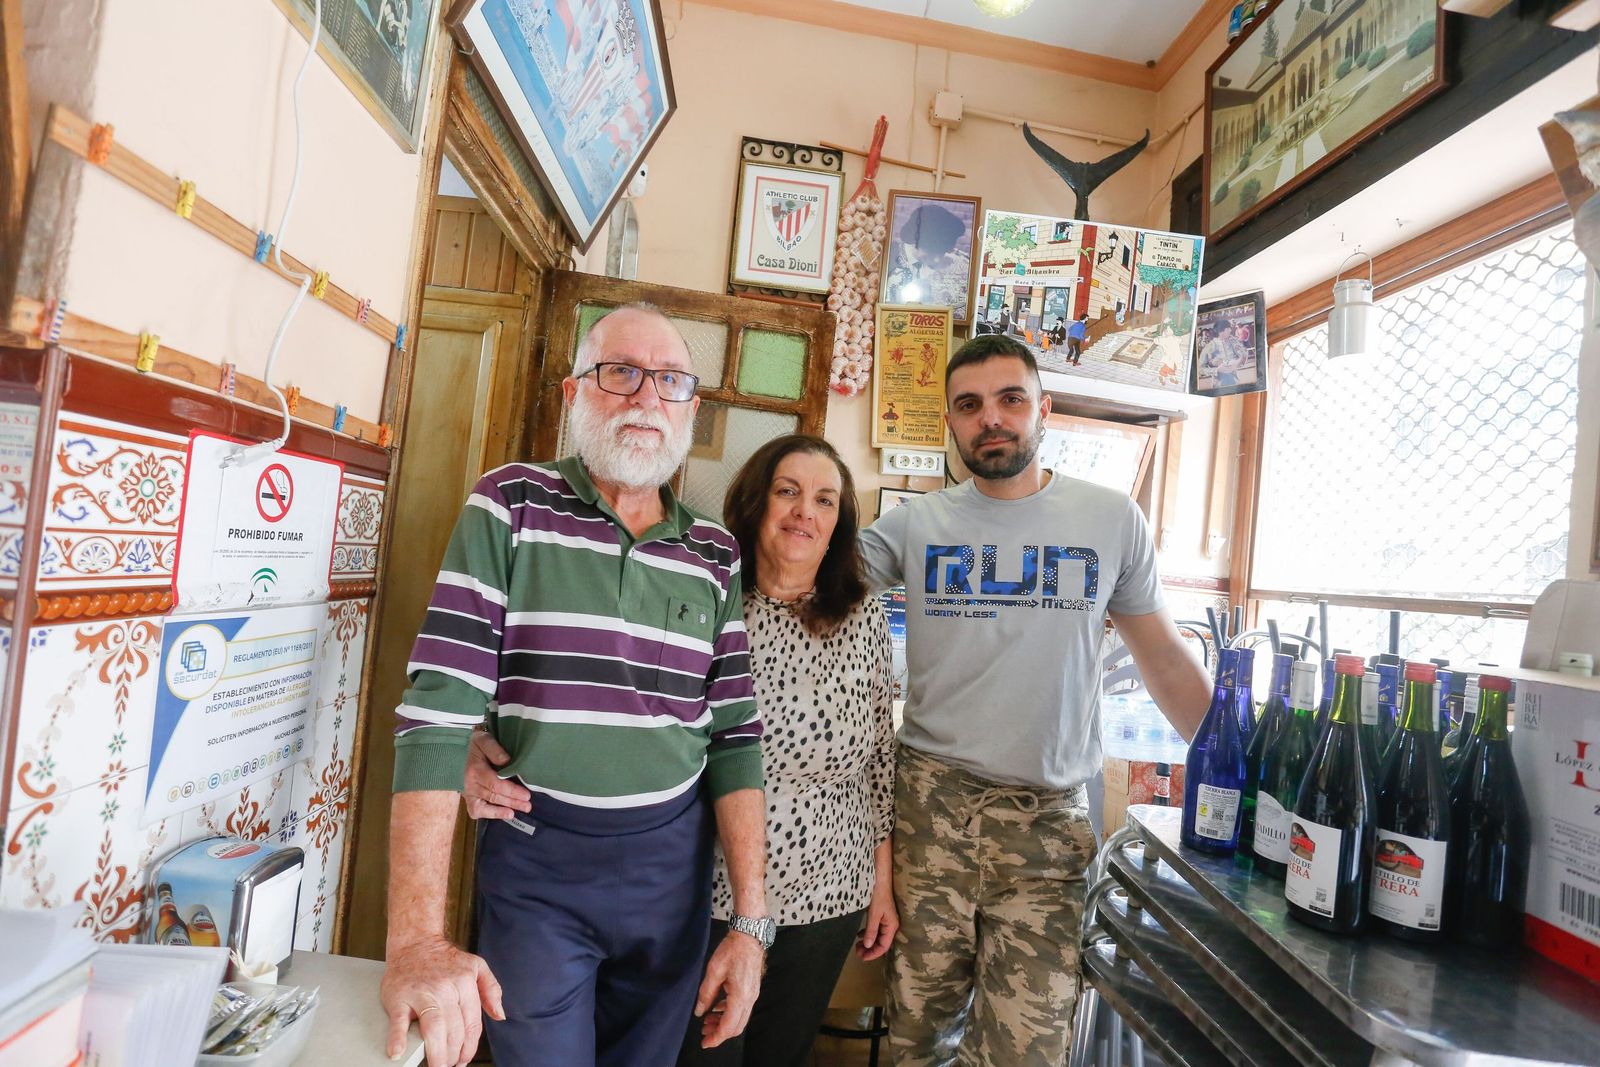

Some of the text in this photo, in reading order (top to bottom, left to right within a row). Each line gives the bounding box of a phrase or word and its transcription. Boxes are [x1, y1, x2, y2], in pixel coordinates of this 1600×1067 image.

[766, 190, 818, 202] ATHLETIC CLUB
[776, 235, 802, 251] BILBAO
[756, 254, 818, 273] Casa Dioni
[1156, 260, 1177, 268] CARACOL
[1157, 254, 1175, 262] TEMPLO
[909, 313, 945, 327] TOROS
[228, 528, 304, 542] PROHIBIDO FUMAR
[924, 608, 998, 619] WORRY LESS
[233, 649, 273, 663] REGLAMENTO
[173, 669, 218, 685] securdat
[212, 669, 313, 701] ESTABLECIMIENTO CON INFORMACIÓN
[205, 697, 247, 714] DISPONIBLE
[247, 695, 256, 704] EN
[255, 689, 279, 702] MATERIA
[278, 686, 286, 695] DE
[207, 733, 237, 746] SOLICITEN
[237, 721, 268, 738] INFORMACIÓN
[272, 714, 290, 725] NUESTRO
[274, 730, 291, 741] MUCHAS
[1555, 752, 1593, 771] LÓPEZ
[1301, 860, 1312, 870] DE
[1407, 878, 1421, 888] DE
